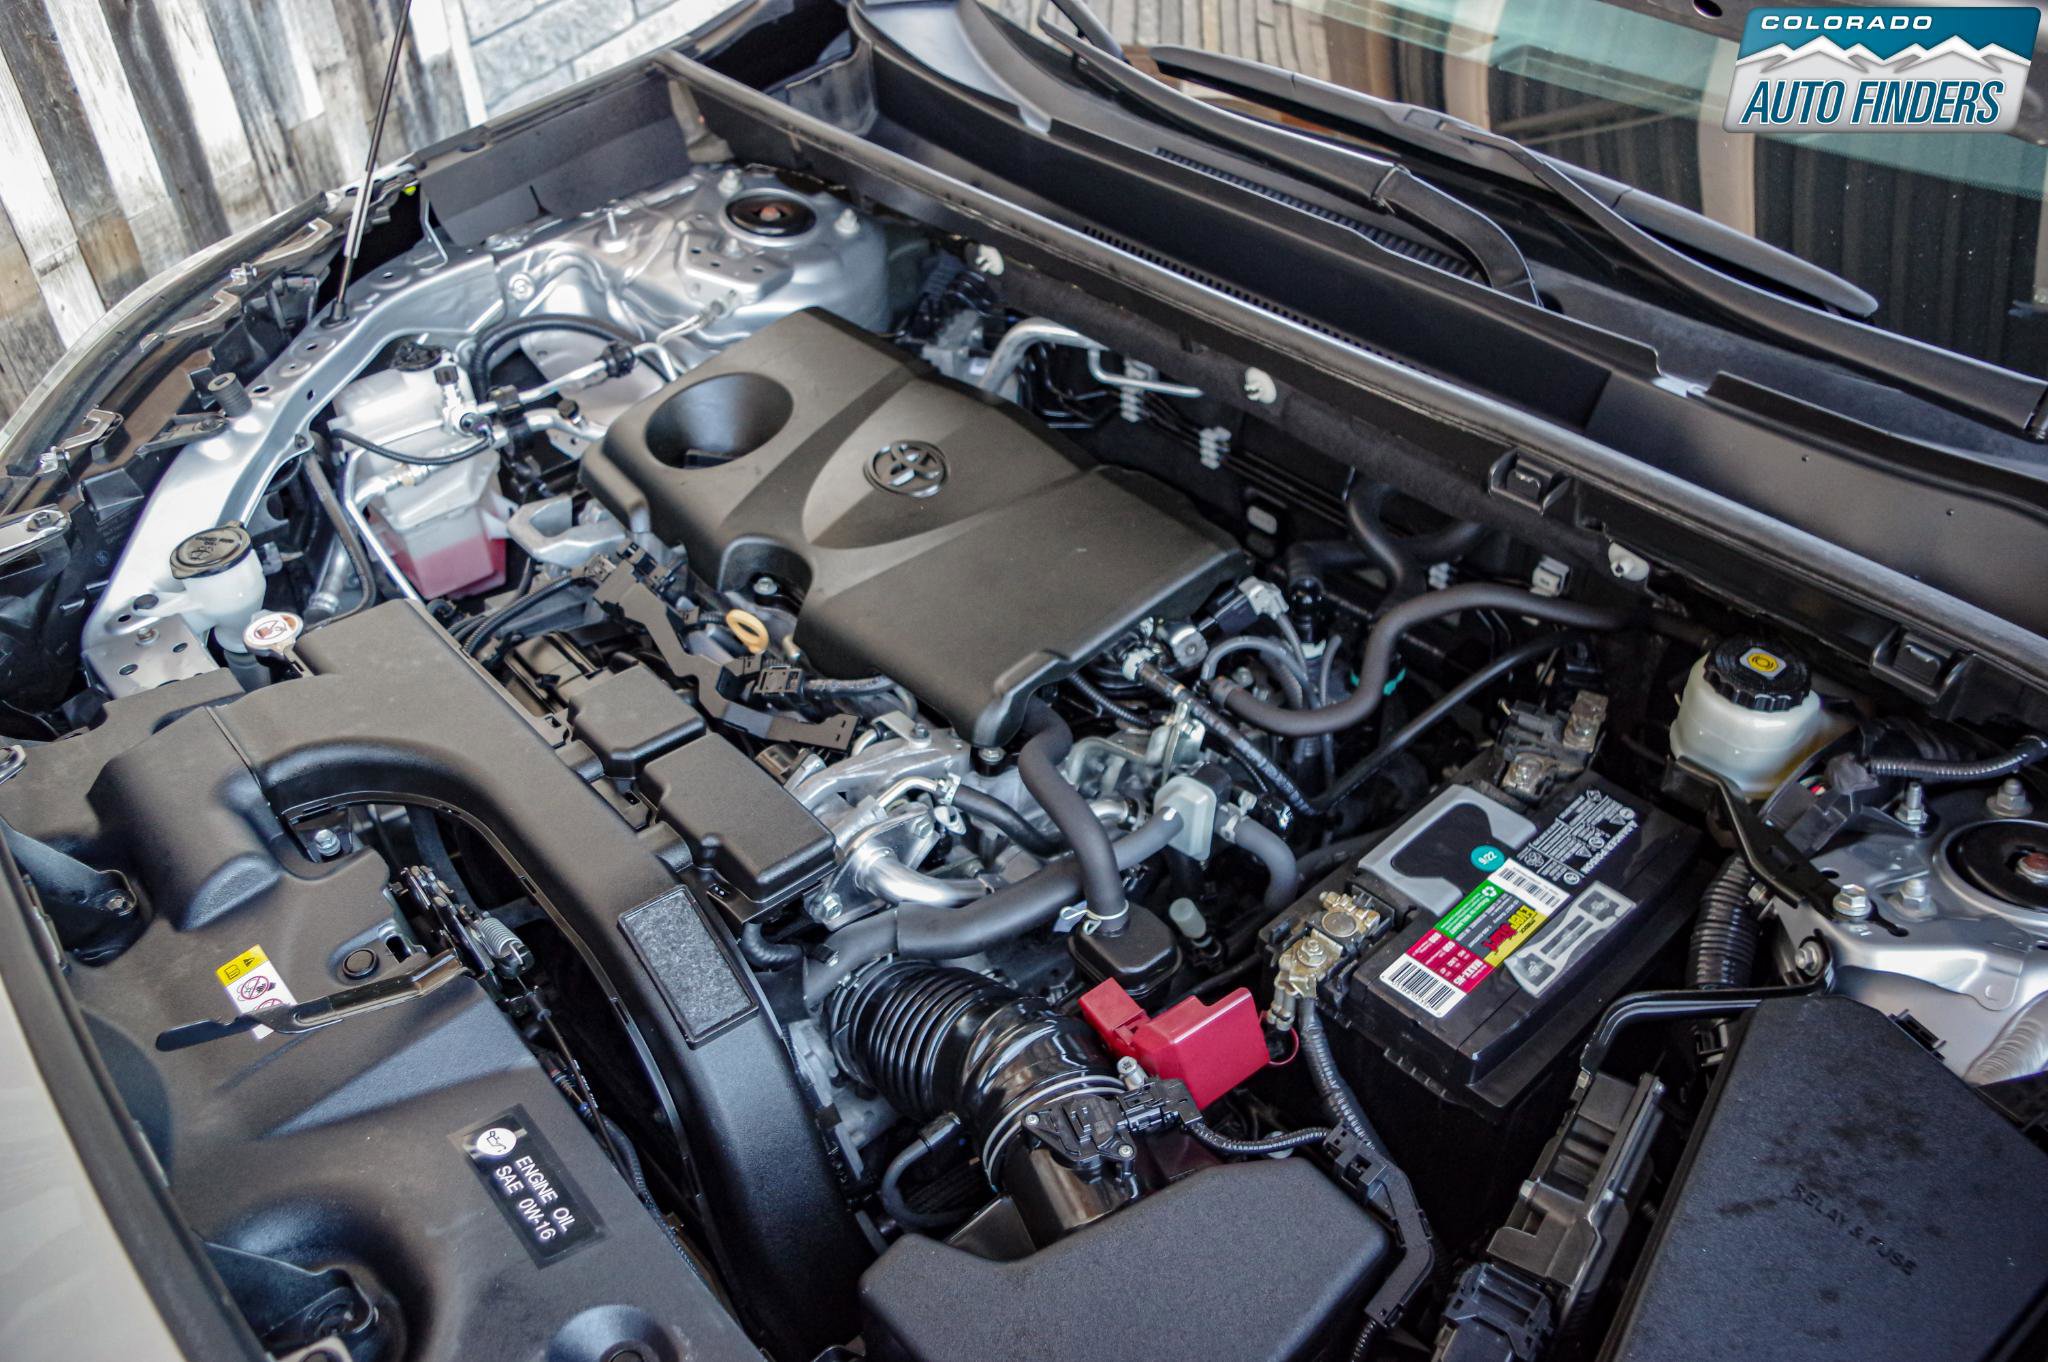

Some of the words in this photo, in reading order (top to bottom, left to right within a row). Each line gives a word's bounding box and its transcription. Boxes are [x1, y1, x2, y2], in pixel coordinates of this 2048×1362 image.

[496, 1164, 524, 1195] SAE
[518, 1198, 556, 1240] 0W-16
[515, 1155, 559, 1204] ENGINE
[553, 1207, 576, 1232] OIL
[1790, 1183, 1849, 1224] RELAY
[1866, 1236, 1919, 1277] FUSE
